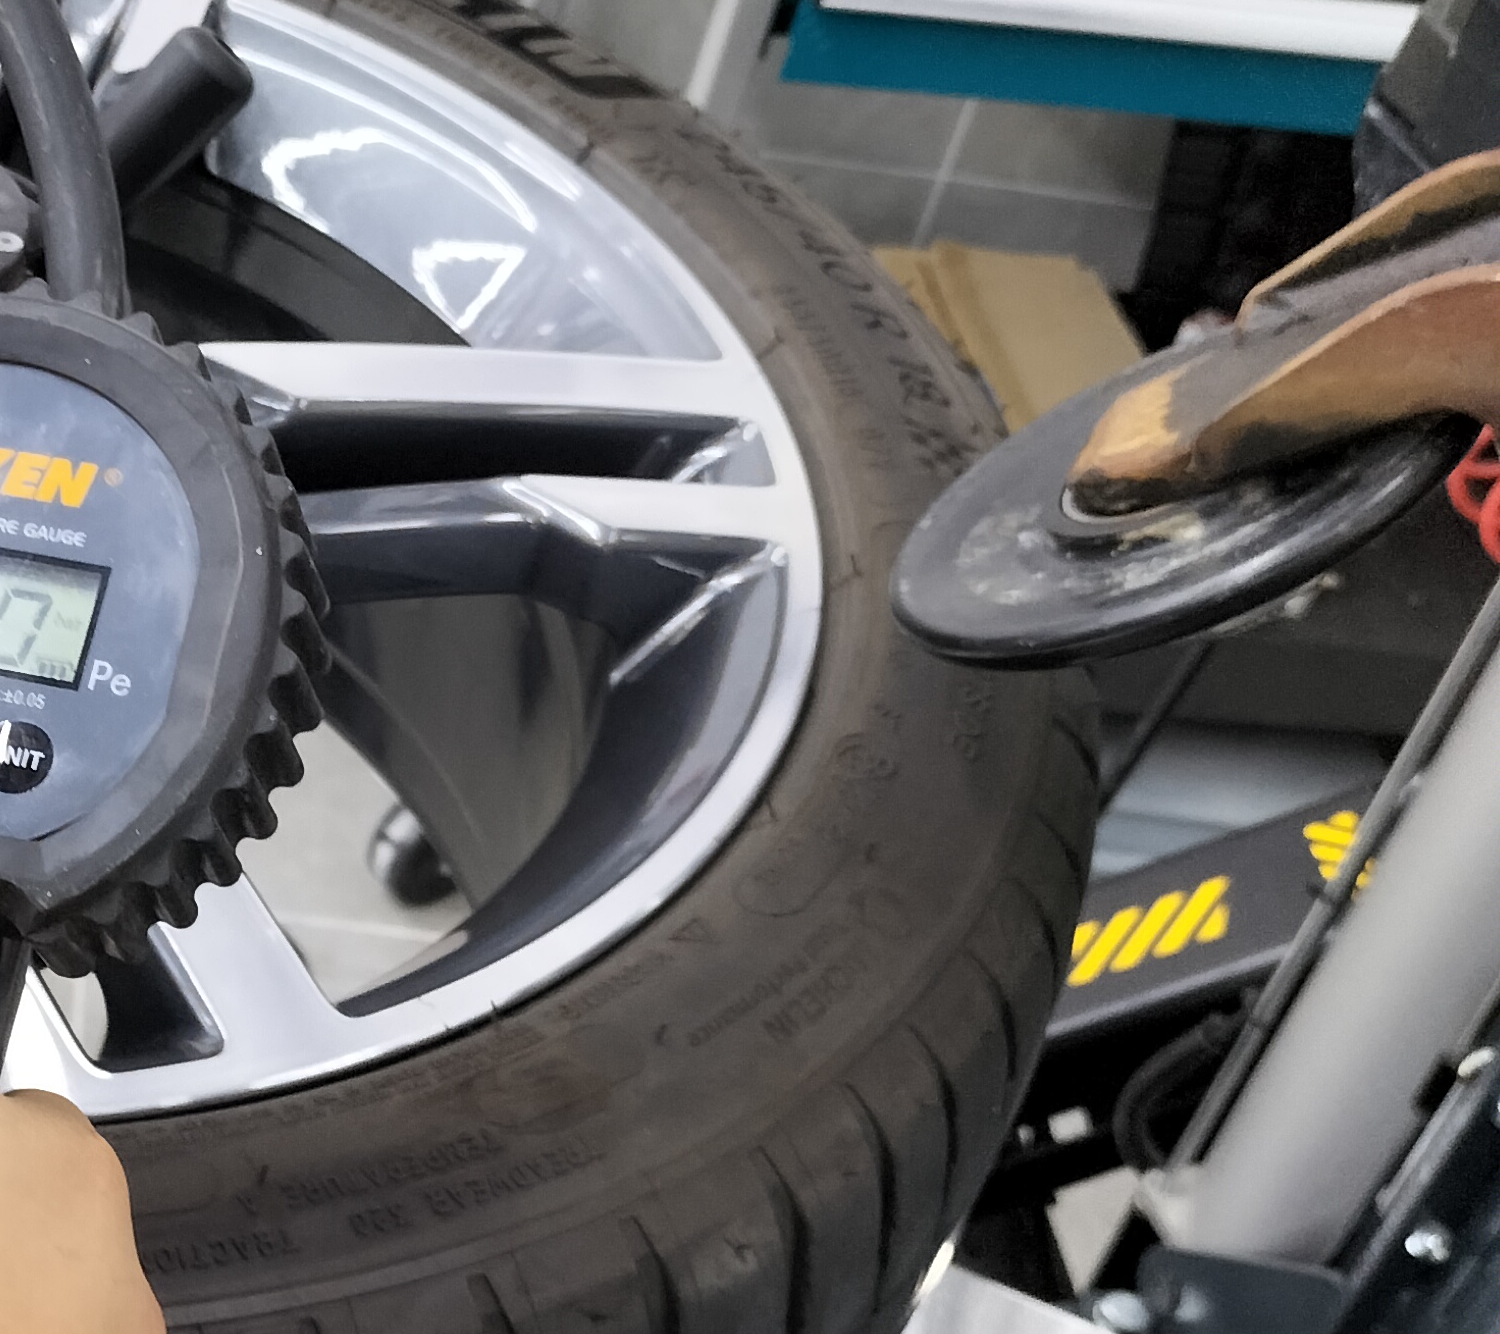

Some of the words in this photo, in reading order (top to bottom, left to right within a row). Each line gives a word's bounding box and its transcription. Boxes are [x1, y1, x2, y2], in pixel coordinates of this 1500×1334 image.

[23, 522, 88, 548] GAUGE
[87, 659, 132, 697] Pe
[148, 1228, 297, 1275] TRACTIO
